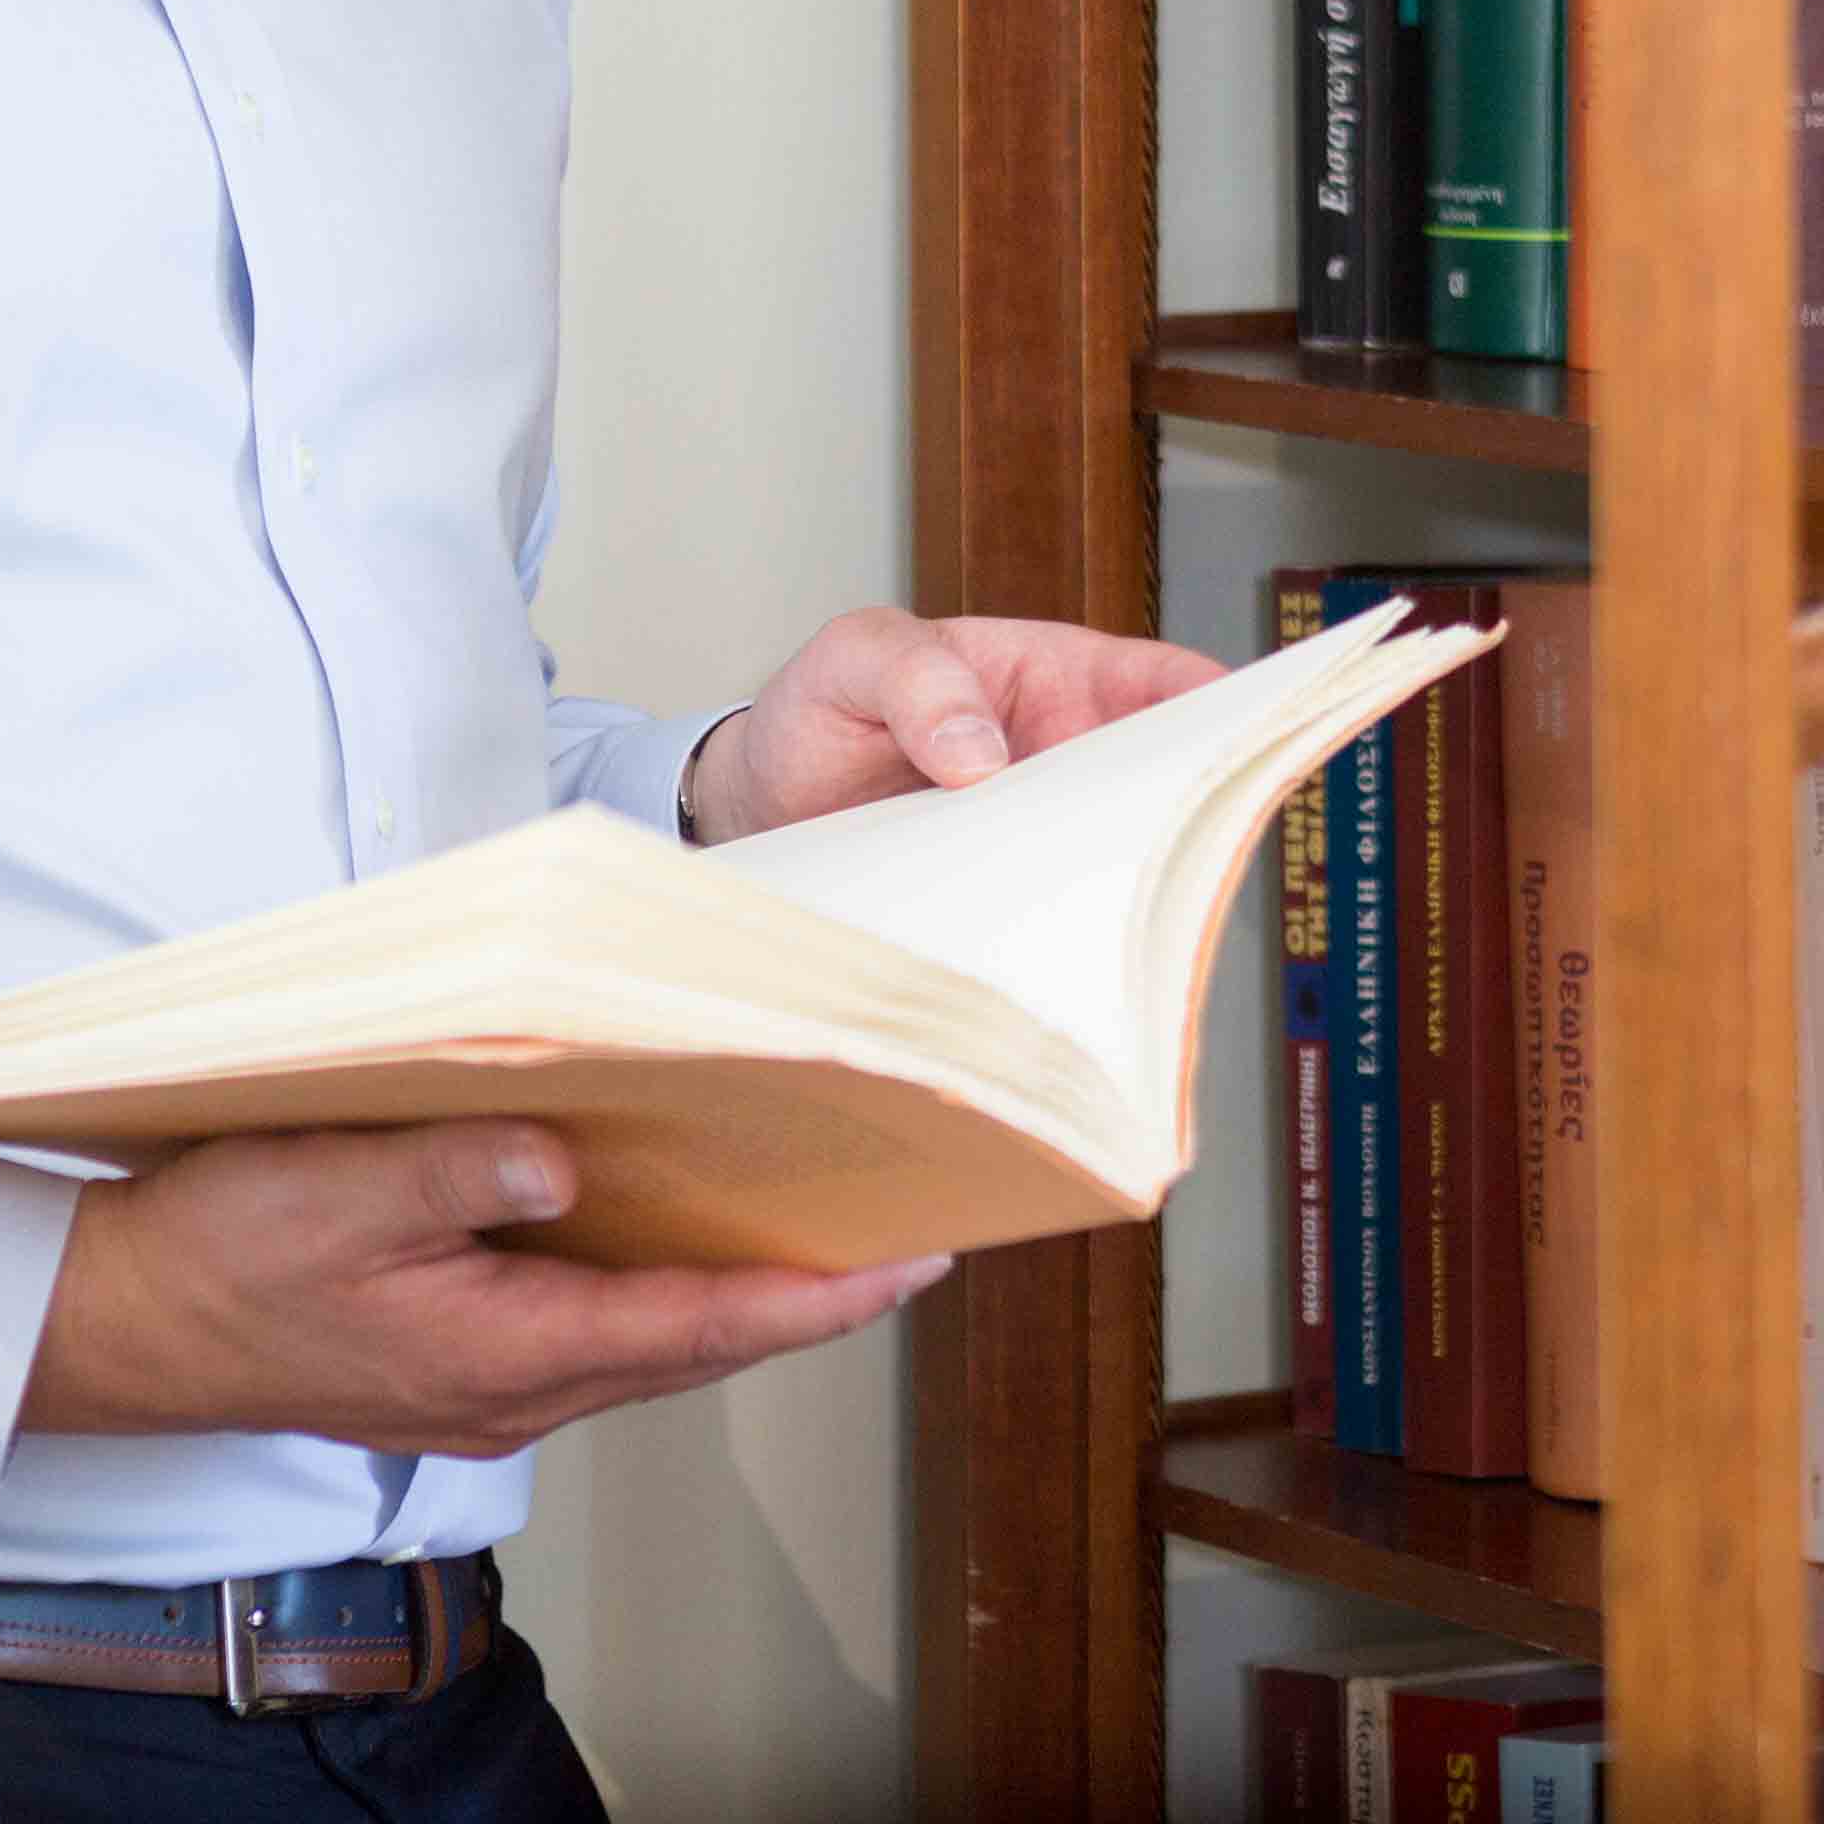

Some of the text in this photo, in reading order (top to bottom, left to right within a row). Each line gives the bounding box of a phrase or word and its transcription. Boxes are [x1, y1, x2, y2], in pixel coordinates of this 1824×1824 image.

[1317, 28, 1360, 216] Εισαγωγή
[1284, 909, 1307, 959] ΟΙ
[1355, 724, 1382, 1077] ΕΛΛΗΝΙΚΗ ΦΙΛΟΣΟ
[1426, 829, 1444, 960] ΕΛΛΗΝΙΚΗ
[1426, 964, 1444, 1057] ΑΡΧΑΙΑ
[1522, 859, 1549, 1249] Προσωπικότητας
[1552, 949, 1592, 1144] θεωρίες
[1298, 1046, 1320, 1172] ΠΕΛΕΓΡΙΝΗΣ
[1300, 1206, 1322, 1327] ΘΕΟΔΟΣΙΟΣ
